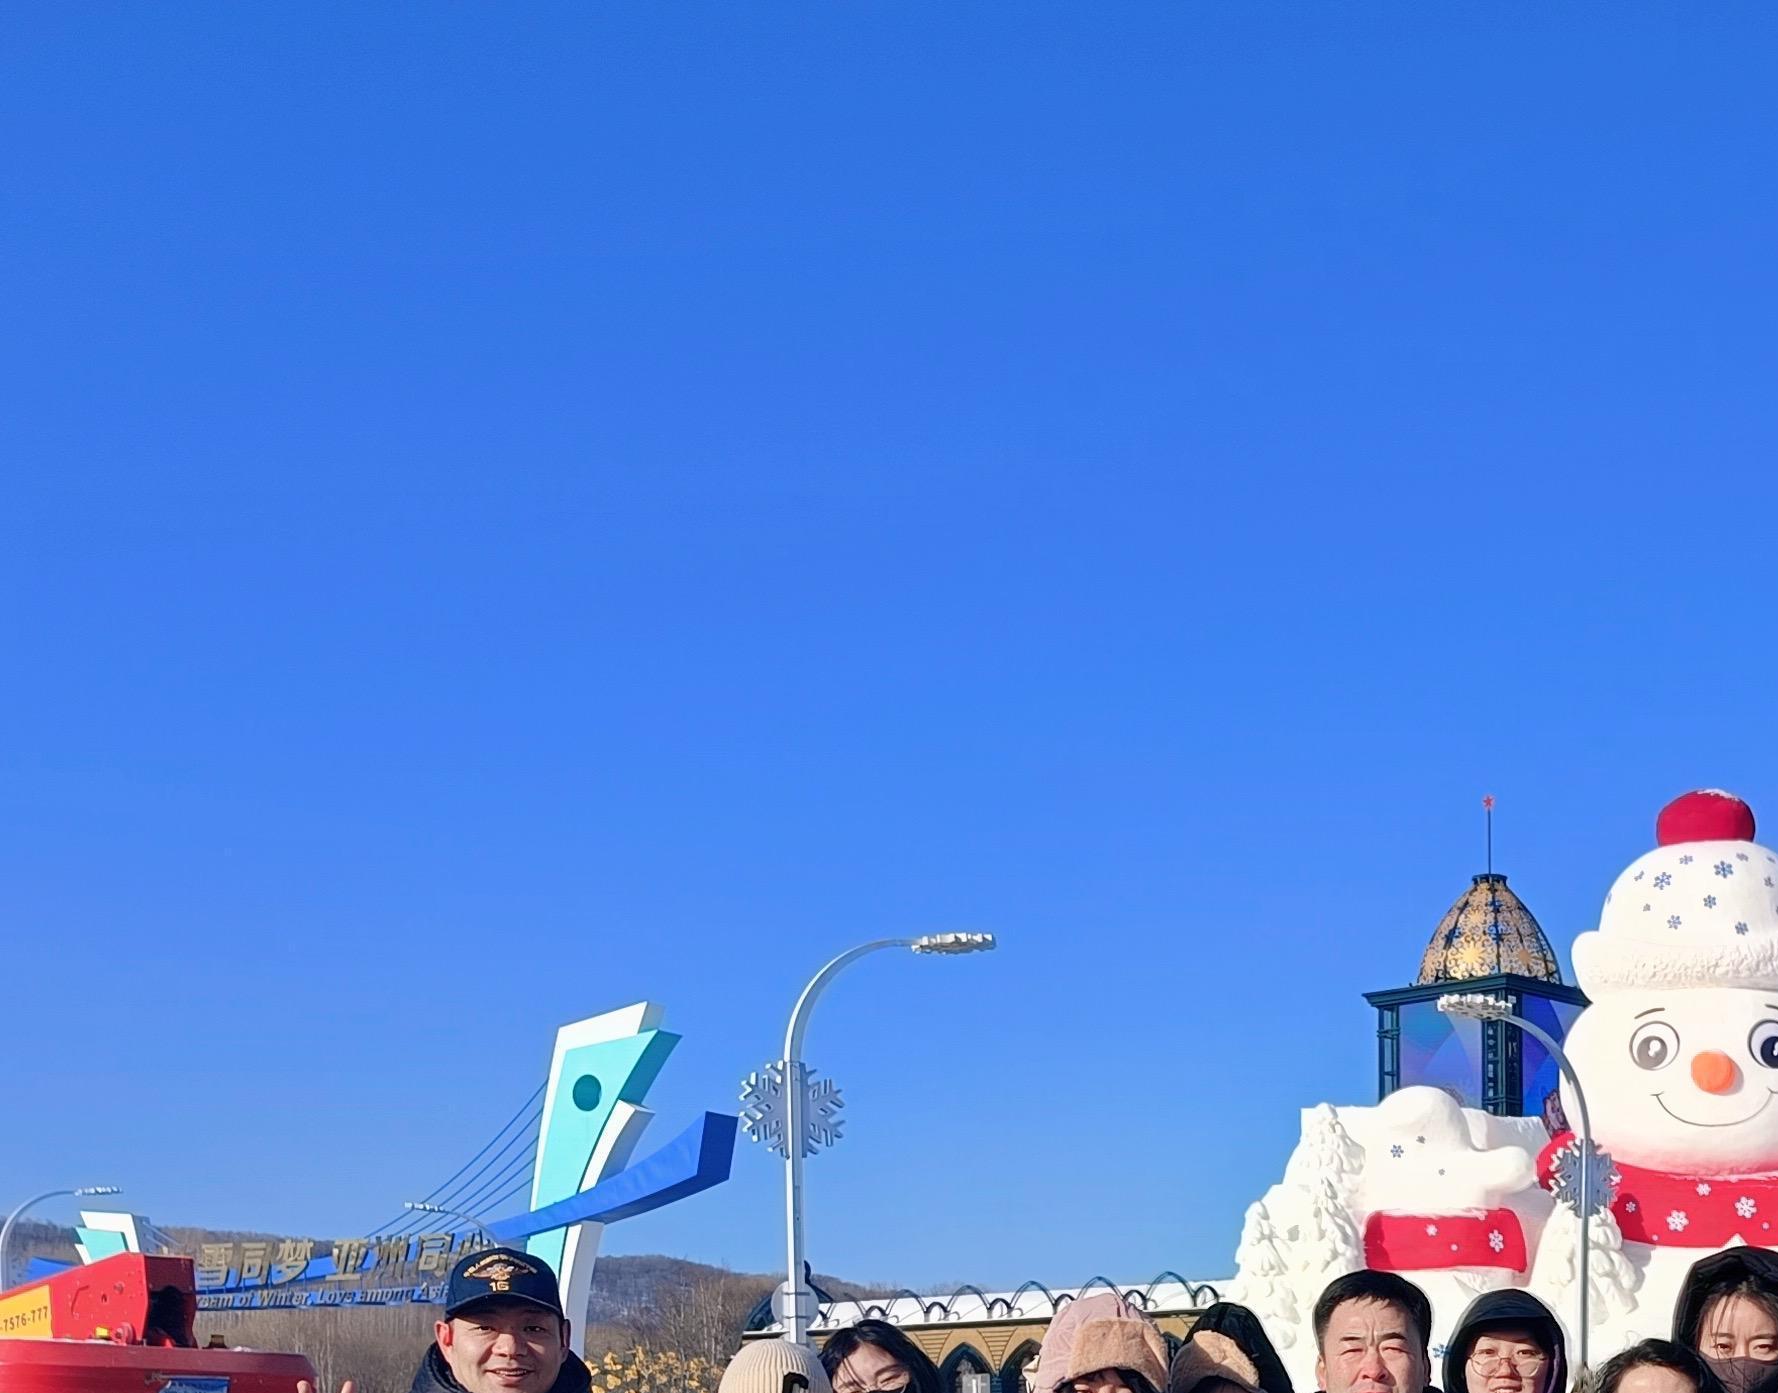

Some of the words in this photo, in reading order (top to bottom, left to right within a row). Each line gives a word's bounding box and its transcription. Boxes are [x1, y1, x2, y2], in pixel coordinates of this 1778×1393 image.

[198, 1239, 313, 1287] 雪同梦
[196, 1294, 234, 1309] ream
